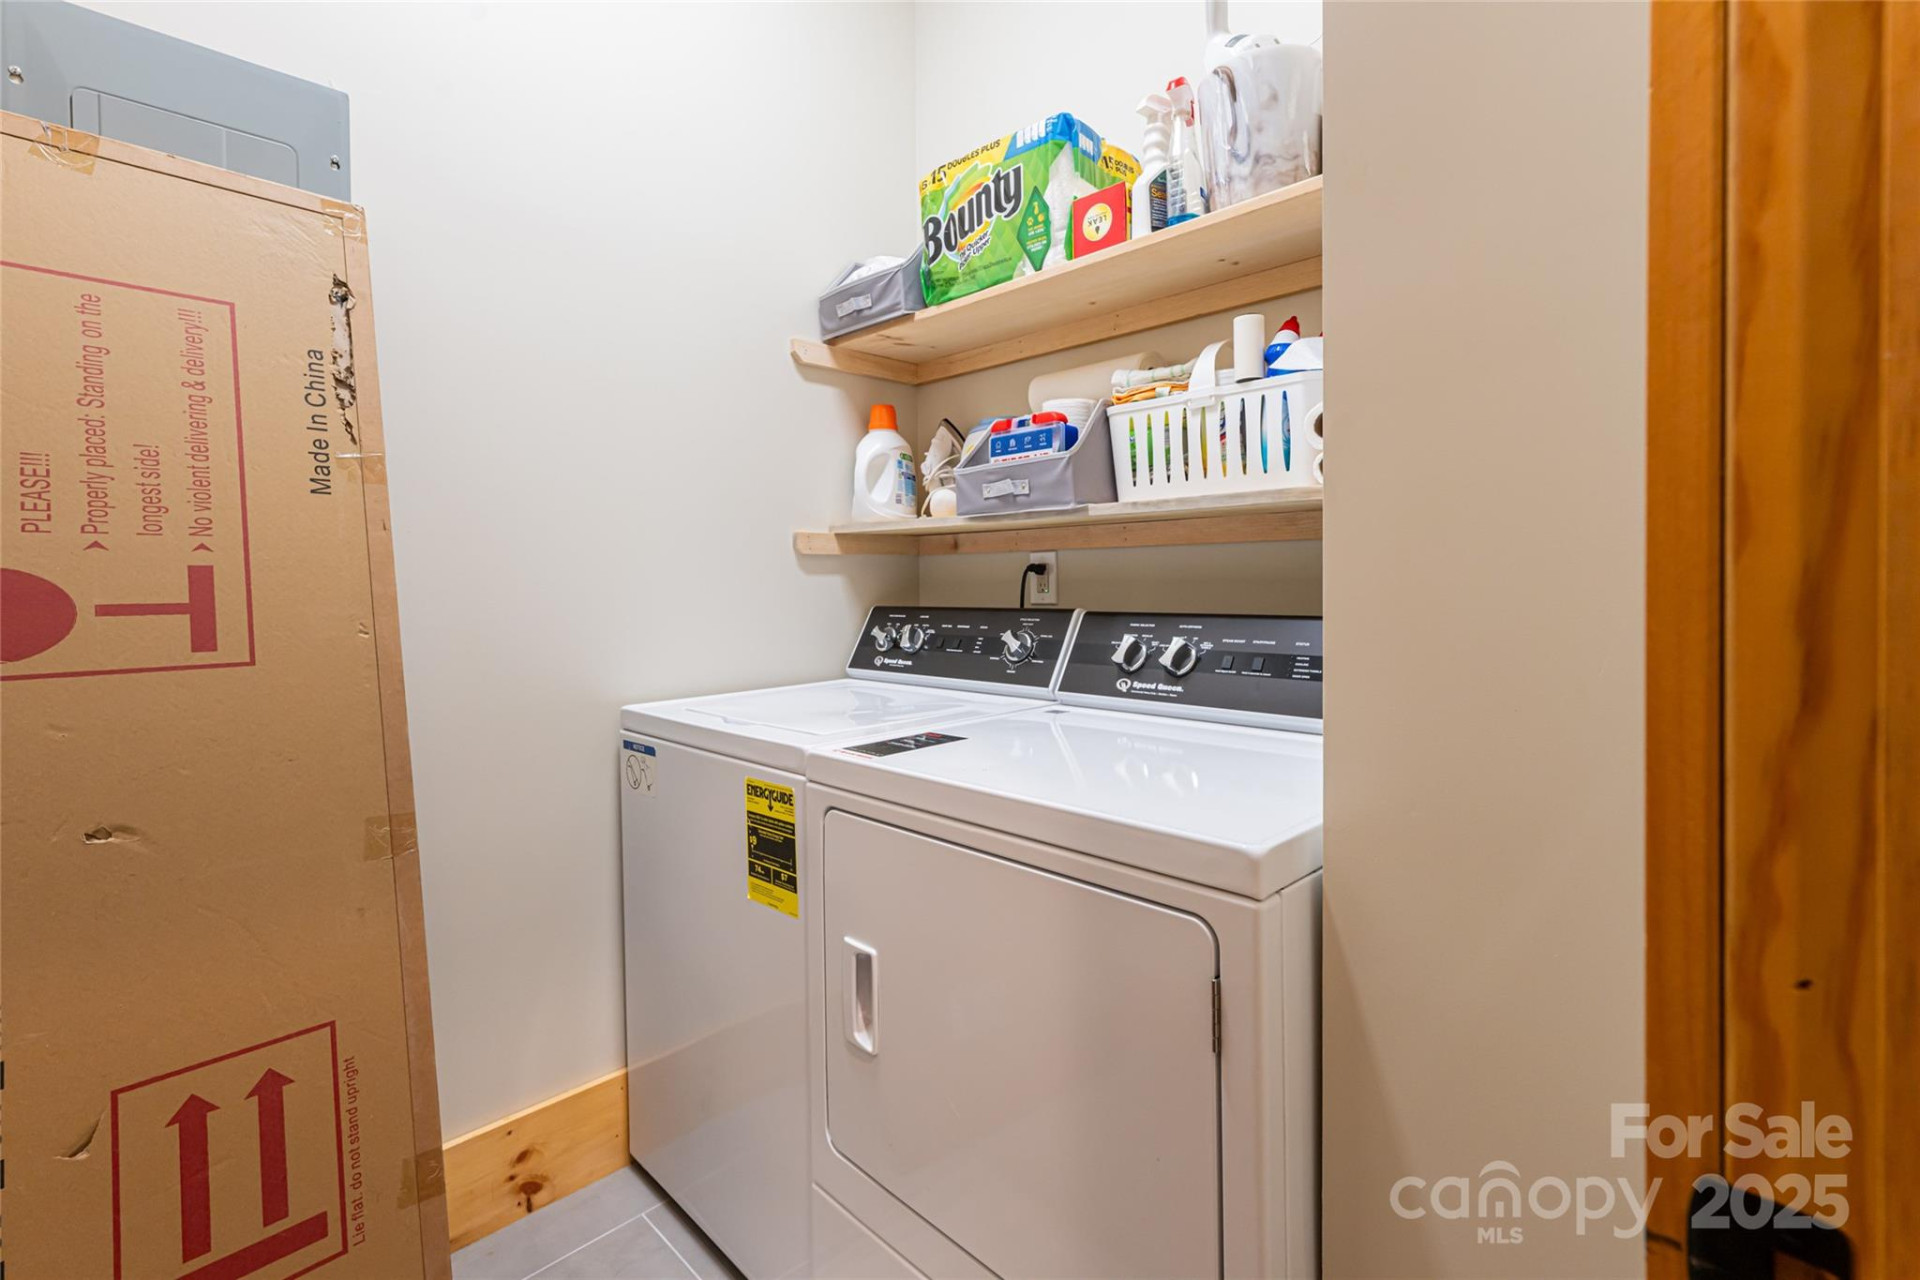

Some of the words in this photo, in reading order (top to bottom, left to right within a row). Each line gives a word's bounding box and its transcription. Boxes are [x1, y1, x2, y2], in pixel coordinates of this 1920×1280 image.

[947, 150, 980, 171] DOUBLES
[980, 139, 1001, 155] PLUS
[923, 164, 1023, 266] Bounty
[1087, 214, 1108, 228] LEAK
[74, 293, 102, 316] the
[80, 320, 103, 339] on
[177, 308, 209, 376] delivery!!!
[75, 344, 111, 409] Standing
[181, 380, 206, 391] &
[304, 348, 326, 408] China
[77, 413, 114, 468] placed:
[182, 394, 214, 462] delivering
[306, 415, 328, 433] In
[132, 443, 161, 479] side!
[310, 439, 331, 496] Made
[19, 451, 52, 534] PLEASE!!!
[78, 471, 116, 535] Properly
[135, 482, 169, 537] longest
[186, 465, 213, 512] violent
[188, 517, 214, 537] No
[343, 1055, 359, 1104] upright
[346, 1106, 359, 1144] stand
[348, 1147, 361, 1169] not
[349, 1172, 363, 1190] do
[352, 1219, 366, 1247] Lie
